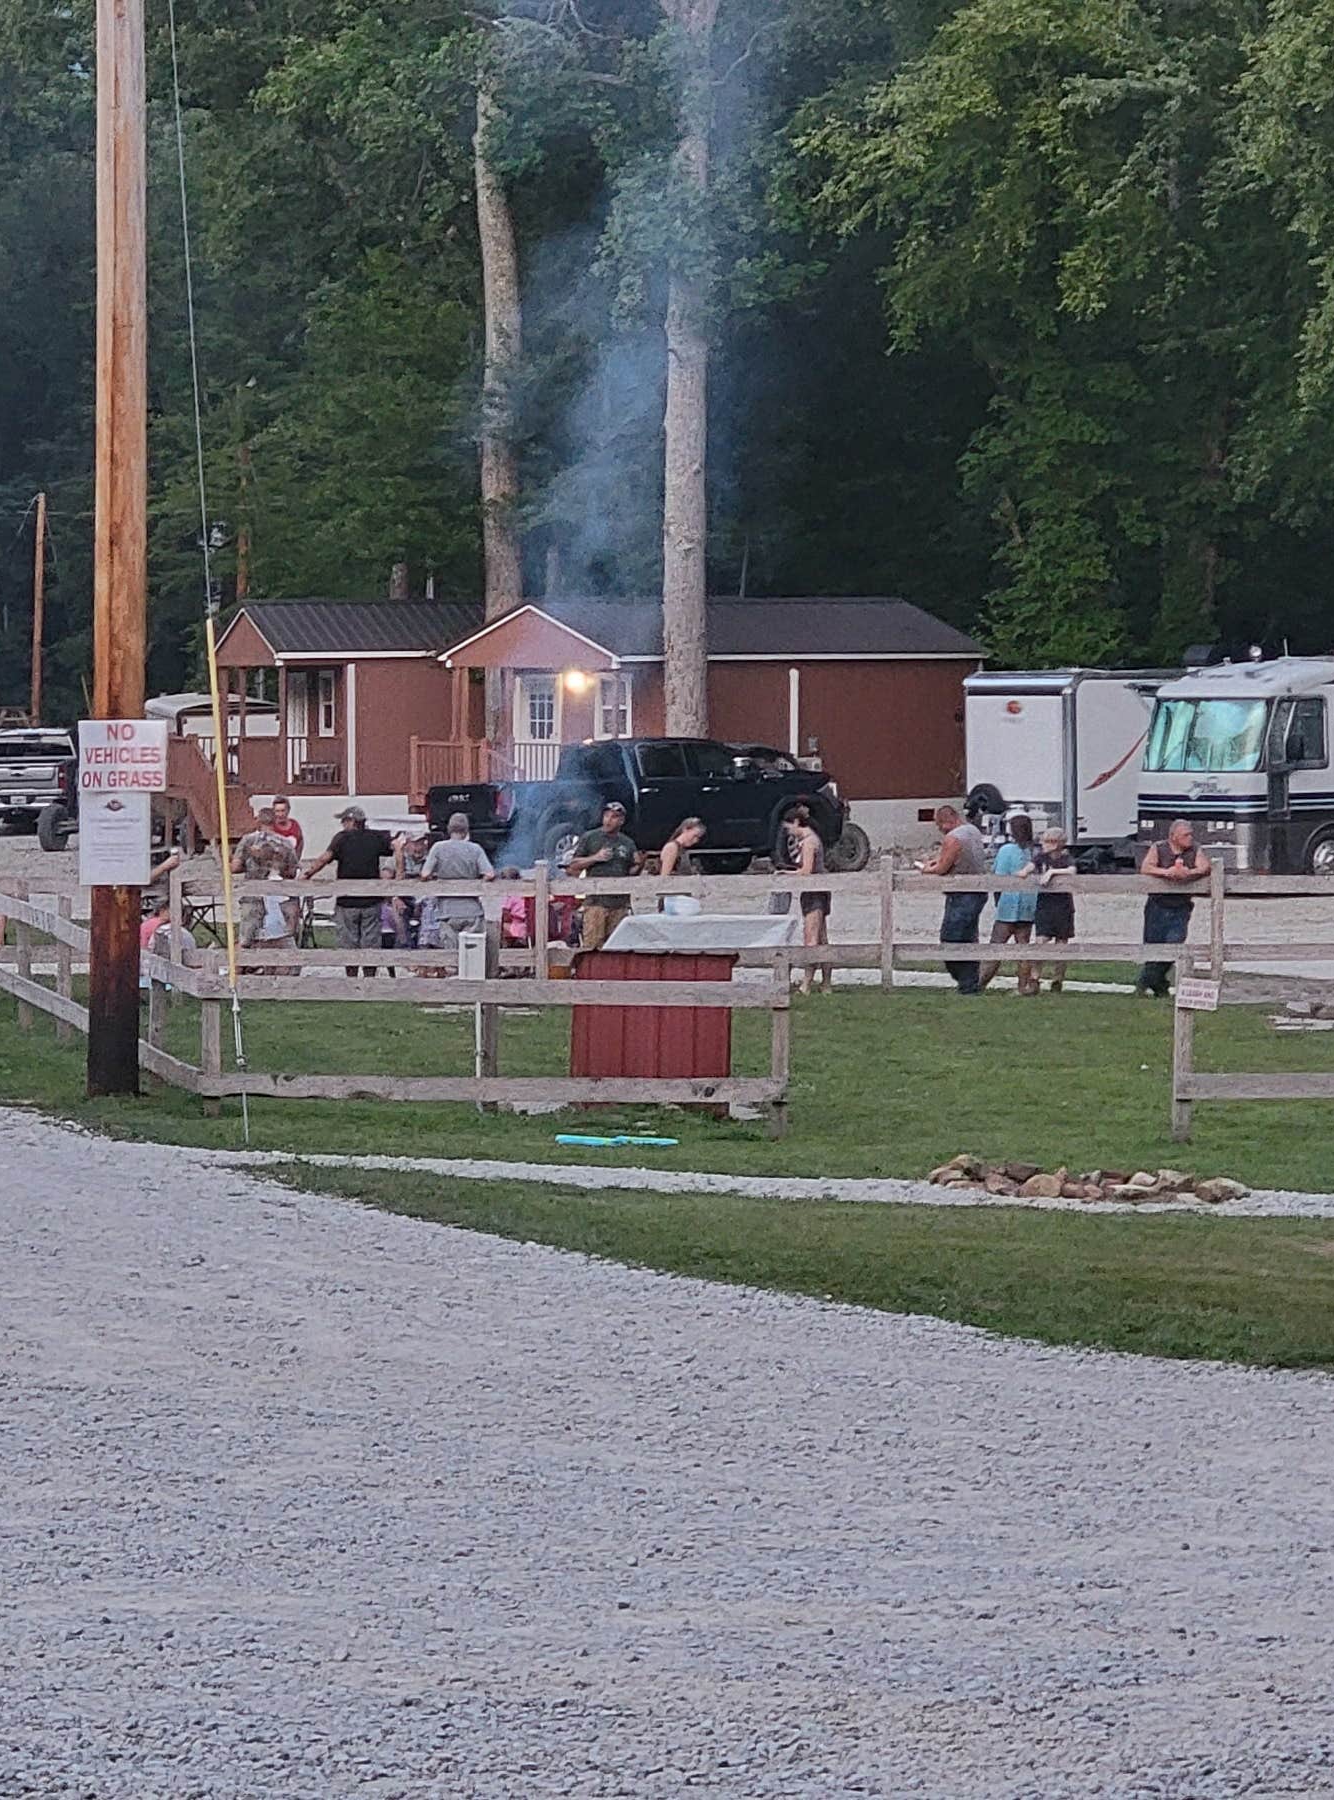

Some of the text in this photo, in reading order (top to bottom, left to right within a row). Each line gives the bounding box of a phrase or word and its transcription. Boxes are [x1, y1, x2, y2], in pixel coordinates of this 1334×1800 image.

[106, 723, 135, 741] NO
[85, 746, 161, 764] VEHICLES
[82, 770, 163, 788] ON GRASS
